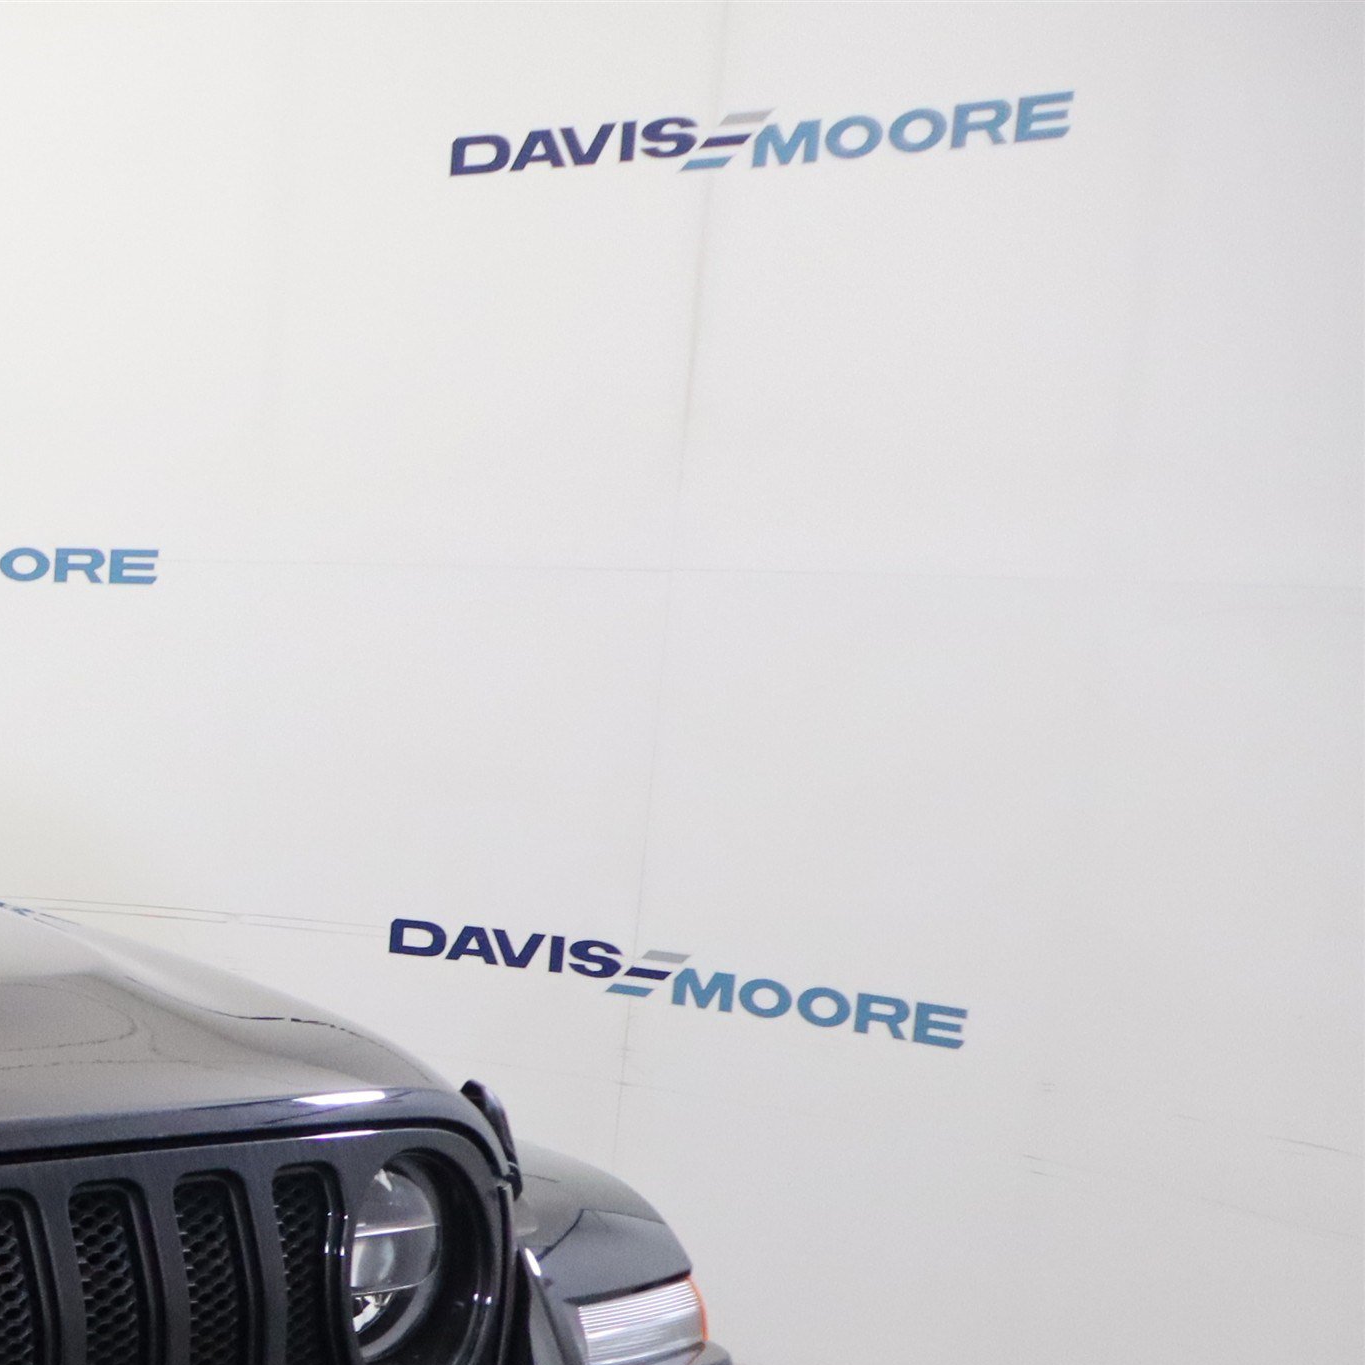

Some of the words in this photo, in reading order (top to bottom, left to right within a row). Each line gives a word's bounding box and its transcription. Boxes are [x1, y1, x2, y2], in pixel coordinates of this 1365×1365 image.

[449, 115, 698, 177] DAVIS
[751, 91, 1075, 169] MOORE
[389, 918, 622, 979] DAVIS
[671, 968, 968, 1050] MOORE
